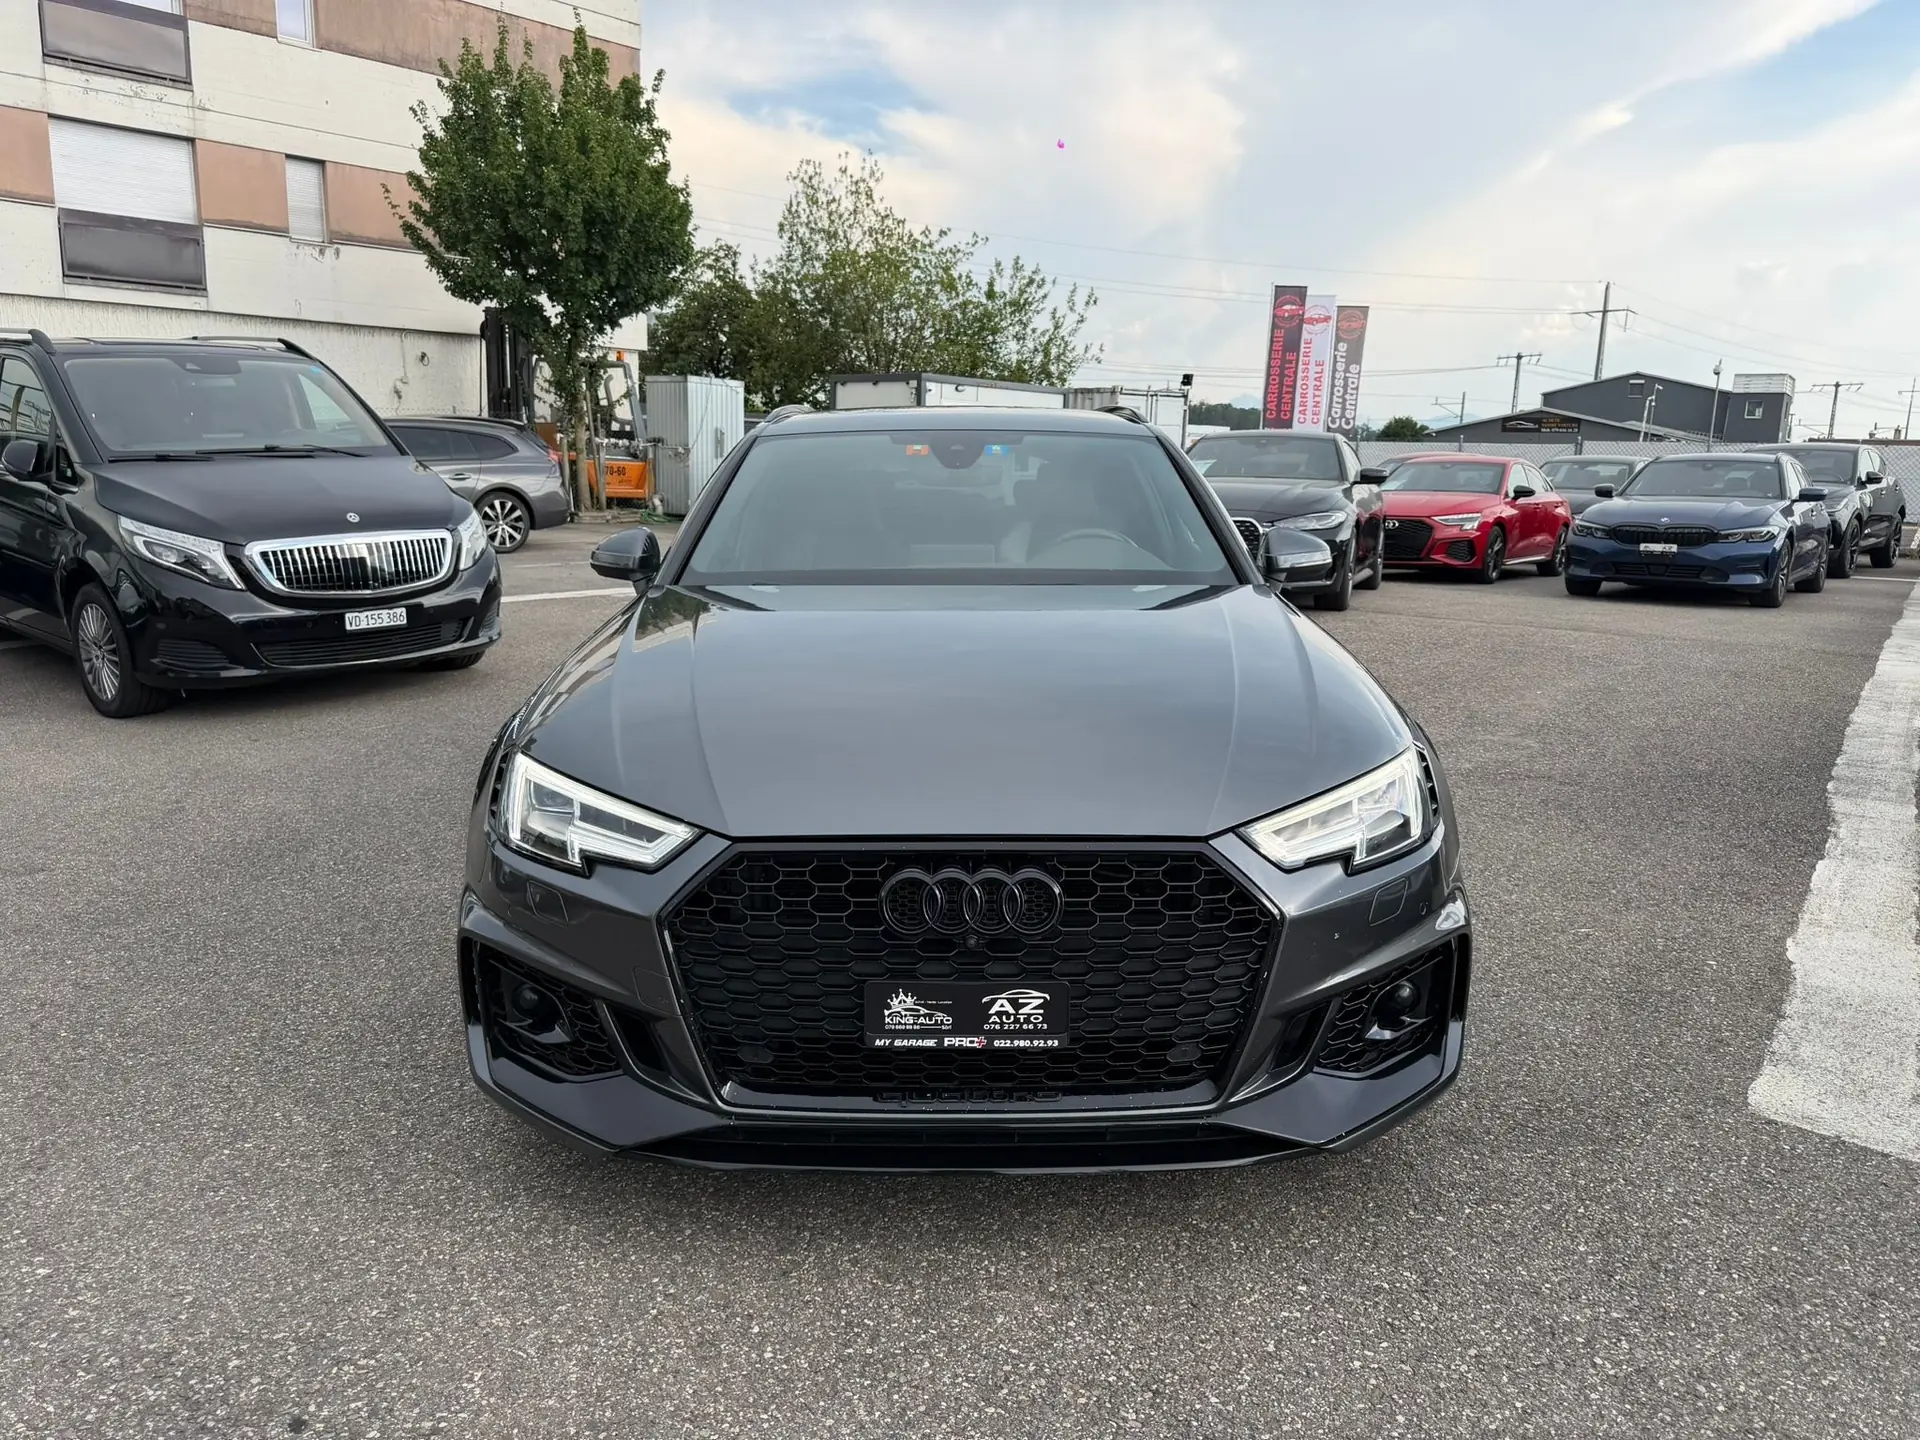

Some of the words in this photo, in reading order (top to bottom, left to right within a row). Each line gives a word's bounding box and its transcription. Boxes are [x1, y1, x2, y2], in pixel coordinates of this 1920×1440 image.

[1266, 328, 1285, 419] CARROSSERIE
[1280, 352, 1297, 419] CENTRALE
[1297, 338, 1313, 424] CARROSSERIE
[1311, 360, 1325, 425] CENTRALE
[1328, 342, 1348, 428] Carrosserie
[1341, 363, 1361, 430] Centrale
[988, 999, 1045, 1014] AZ
[988, 1015, 1043, 1023] AUTO
[875, 1039, 892, 1047] MY
[894, 1039, 938, 1047] GARAGE
[993, 1039, 1059, 1047] 022.980.92.93
